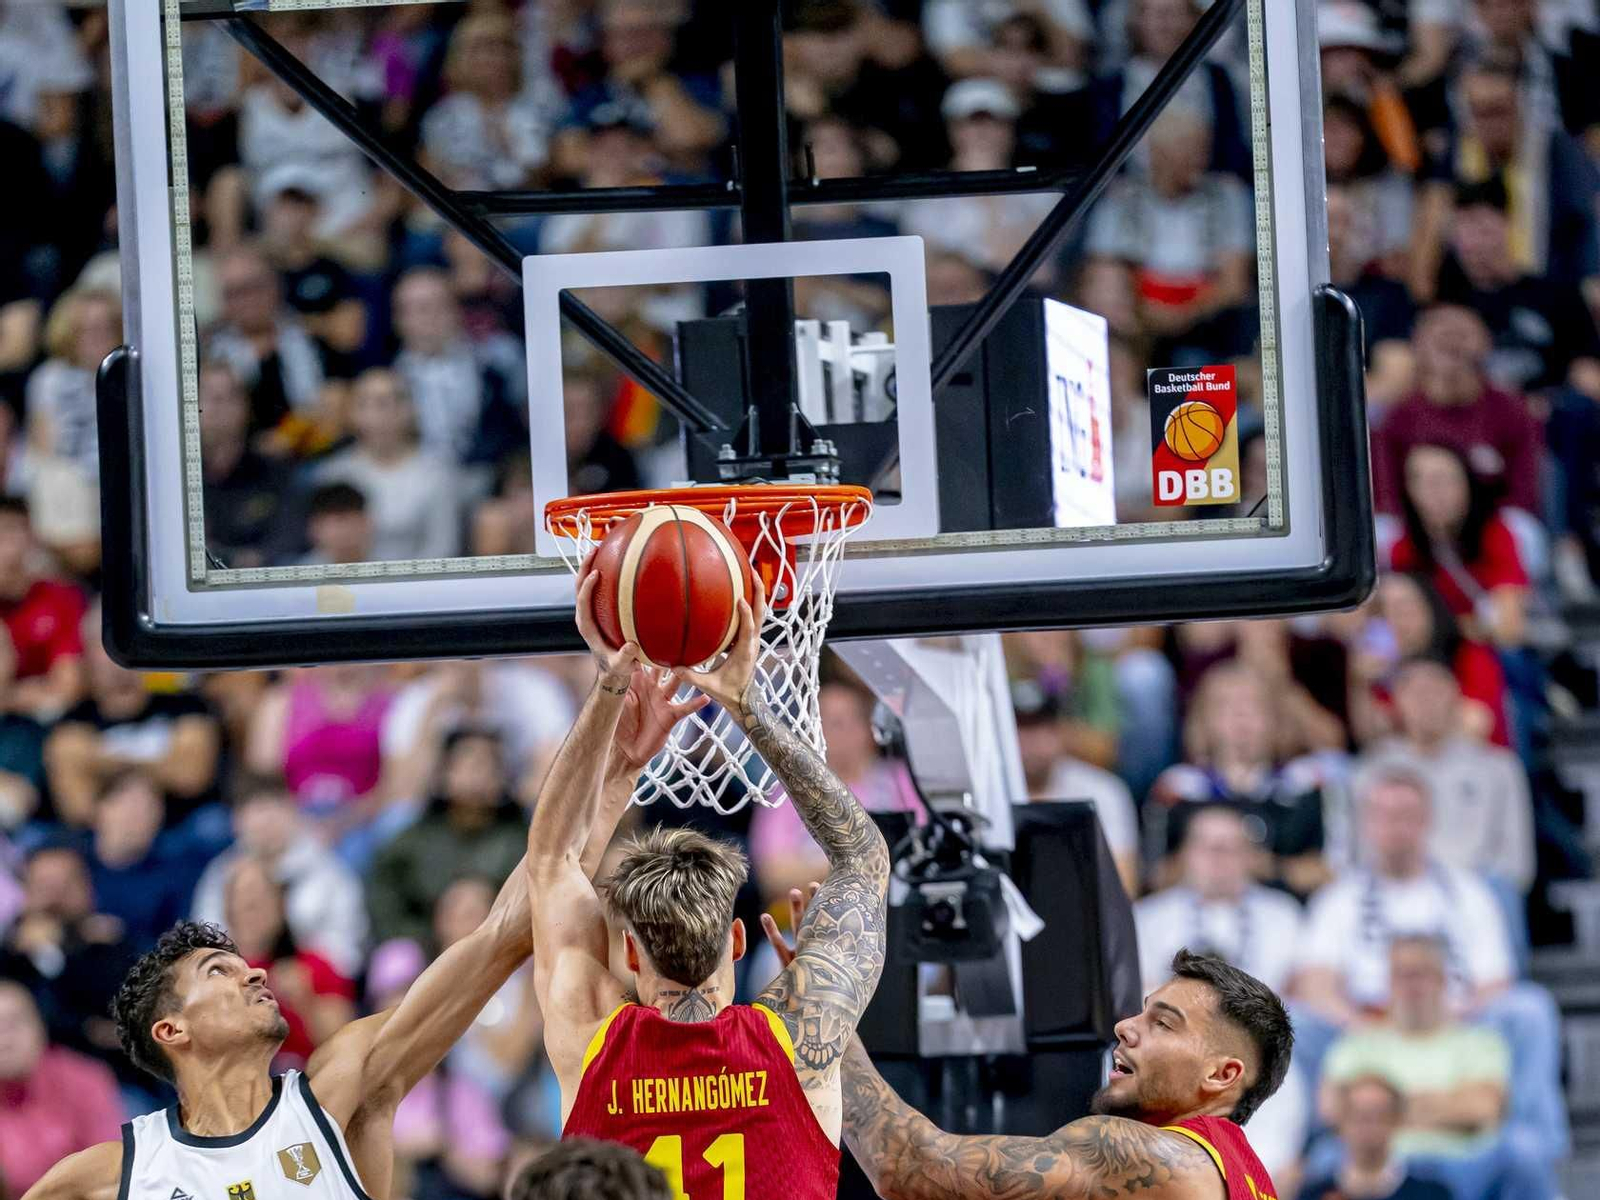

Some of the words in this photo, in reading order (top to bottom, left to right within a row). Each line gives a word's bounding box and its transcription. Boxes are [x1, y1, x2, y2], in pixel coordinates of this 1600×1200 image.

[1154, 382, 1204, 393] Basketball
[1206, 380, 1231, 391] Bund
[1168, 371, 1216, 382] Deutscher
[1158, 468, 1234, 501] DBB
[607, 1080, 624, 1115] J.
[632, 1066, 770, 1114] HERNANGÓMEZ
